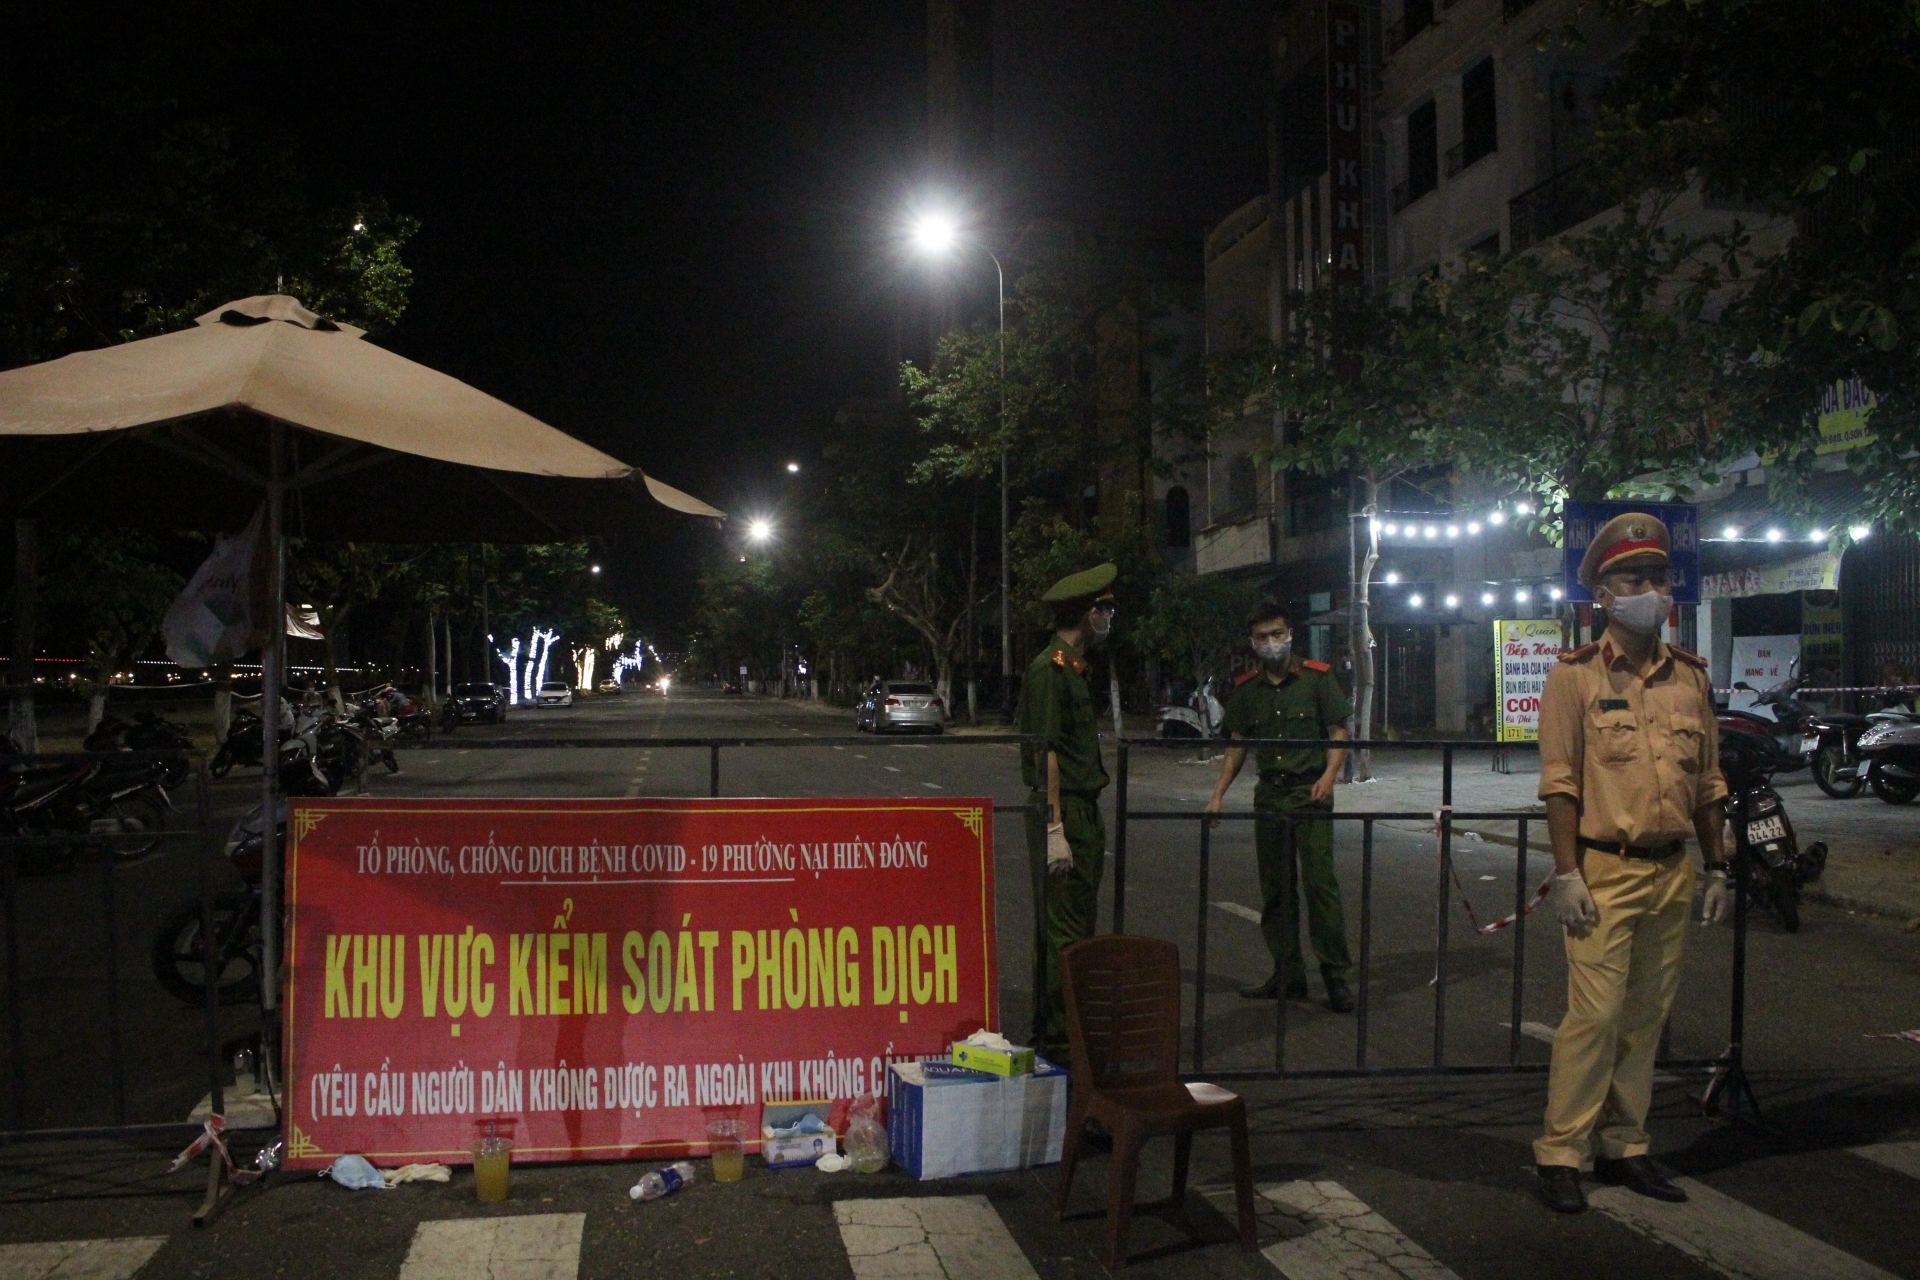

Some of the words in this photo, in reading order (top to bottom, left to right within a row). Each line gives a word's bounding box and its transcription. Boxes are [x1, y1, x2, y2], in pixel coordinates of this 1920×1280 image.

[1337, 158, 1360, 300] KHA
[1525, 623, 1557, 637] Quán
[1505, 643, 1528, 658] Bếp
[1506, 660, 1520, 675] BÁNH
[1522, 662, 1529, 675] ĐA
[1531, 662, 1541, 675] CUA
[1745, 668, 1763, 677] MANG
[1506, 677, 1517, 694] BÚN
[1507, 729, 1520, 738] 171
[357, 830, 381, 873] TỔ
[387, 837, 455, 878] PHÒNG,
[459, 830, 523, 874] CHỐNG
[528, 845, 572, 881] DỊCH
[579, 839, 627, 881] BỆNH
[631, 844, 686, 873] COVID
[700, 844, 718, 872] 19
[723, 835, 795, 871] PHƯỜNG
[800, 843, 829, 879] NẠI
[834, 835, 875, 870] HIÊN
[880, 834, 929, 869] ĐÔNG
[324, 933, 406, 1019] KHU
[418, 925, 495, 1037] VỰC
[509, 897, 608, 1017] KIỂM
[621, 913, 719, 1014] SOÁT
[731, 908, 860, 1012] PHÒNG
[873, 923, 959, 1024] DỊCH
[311, 1064, 357, 1121] (YÊU
[364, 1057, 406, 1116] CẦU
[412, 1061, 475, 1115] NGƯỜI
[481, 1060, 523, 1113] DÂN
[530, 1060, 598, 1112] KHÔNG
[604, 1061, 657, 1118] ĐƯỢC
[664, 1065, 689, 1107] RA
[695, 1054, 756, 1105] NGOÀI
[761, 1061, 794, 1102] KHI
[799, 1050, 864, 1101] KHÔNG
[871, 1041, 909, 1098] CẦ
